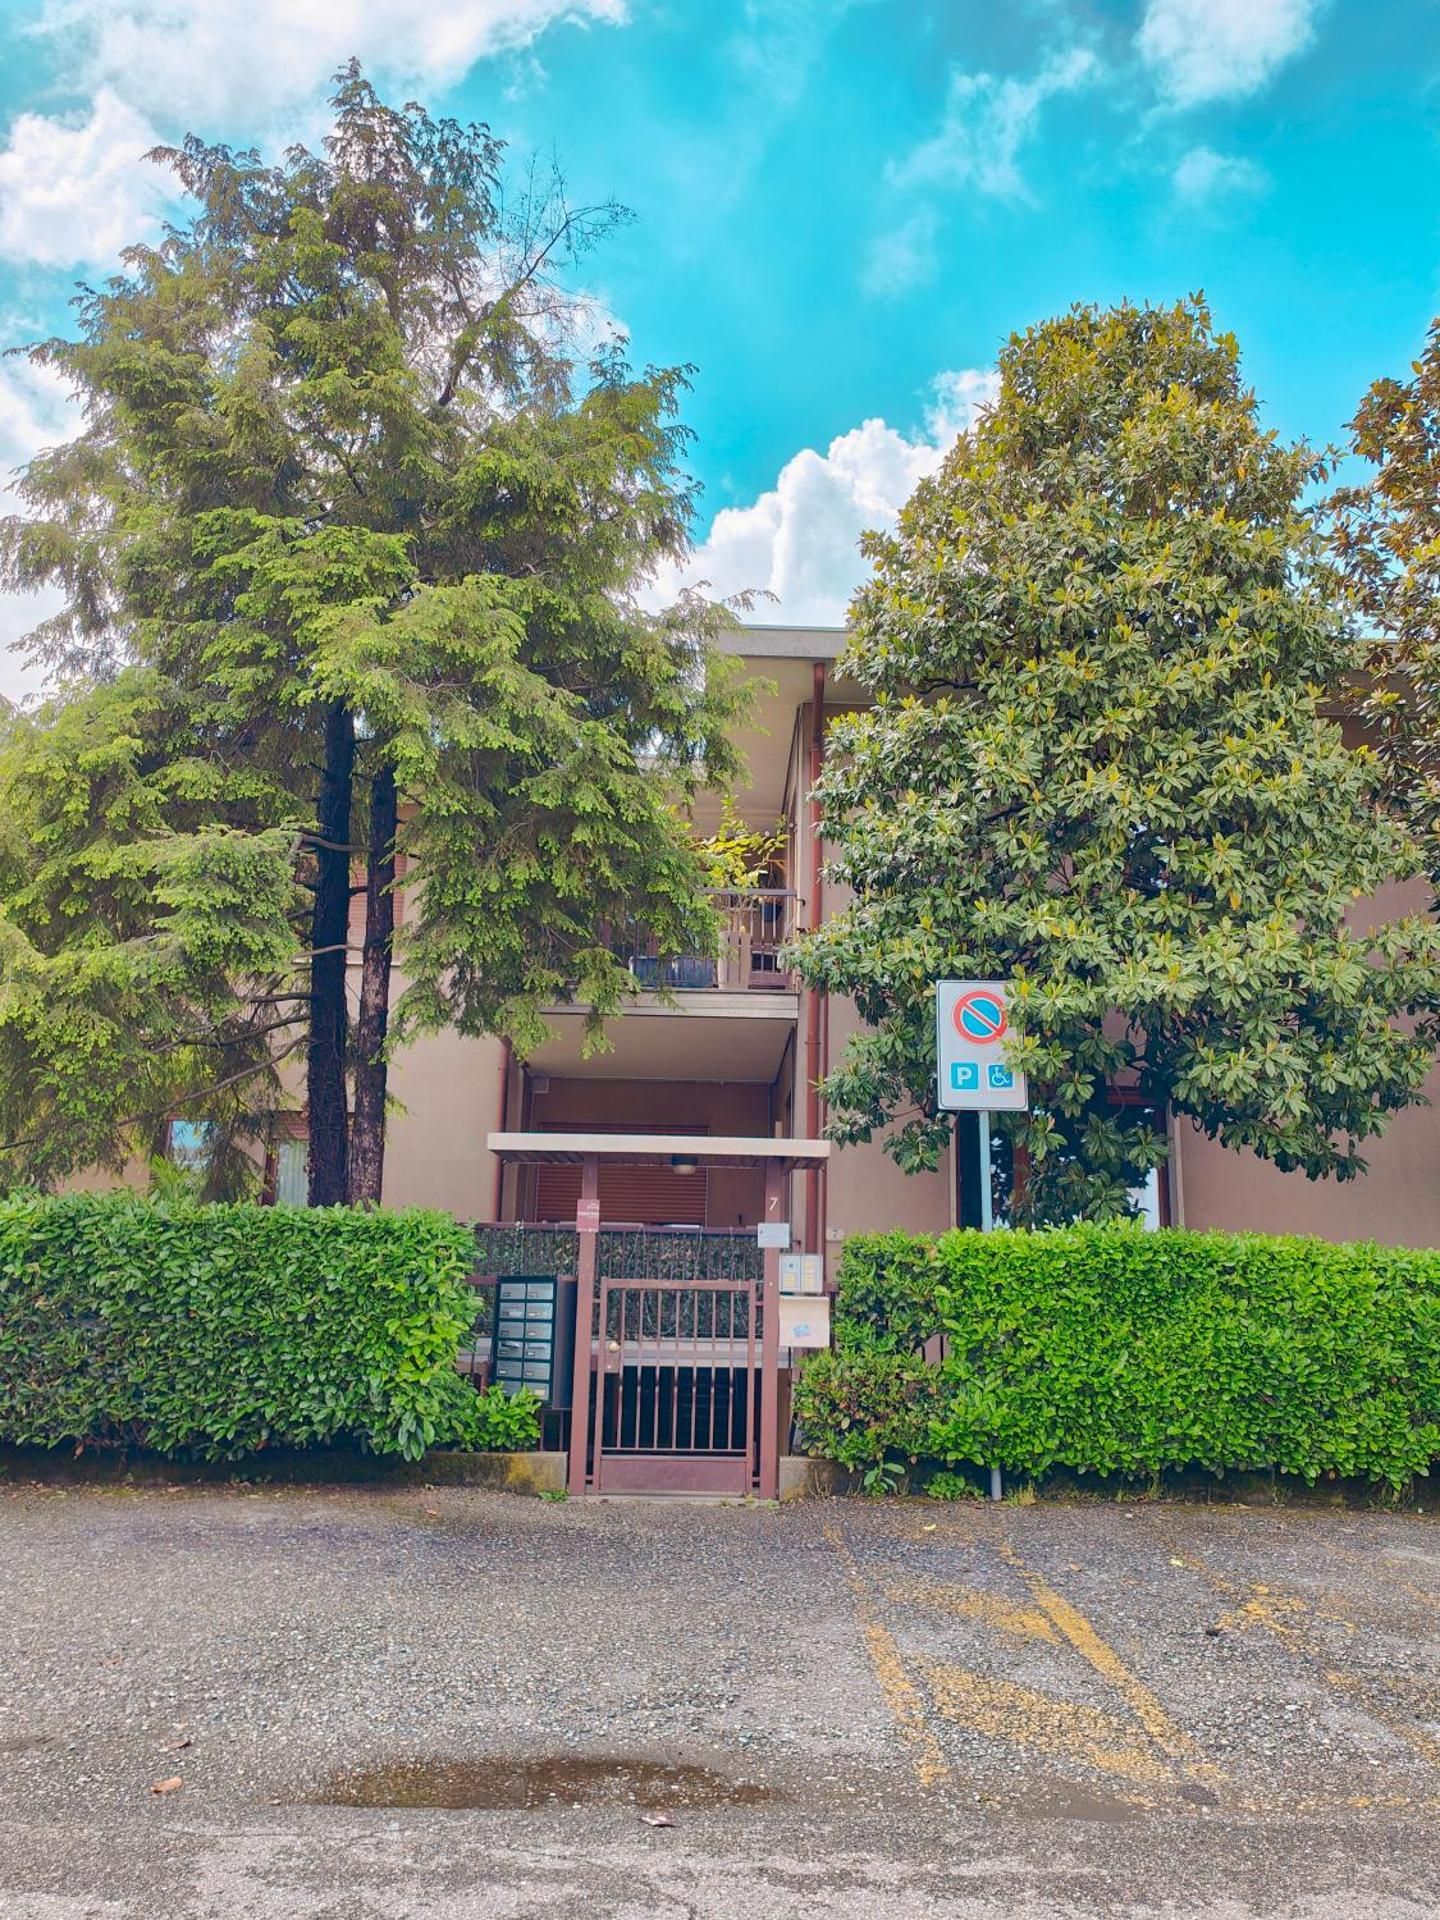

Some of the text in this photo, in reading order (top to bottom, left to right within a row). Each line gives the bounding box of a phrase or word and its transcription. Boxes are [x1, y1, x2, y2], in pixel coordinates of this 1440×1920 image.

[957, 1067, 972, 1085] P
[769, 1197, 778, 1211] 7
[832, 1229, 838, 1239] 7
